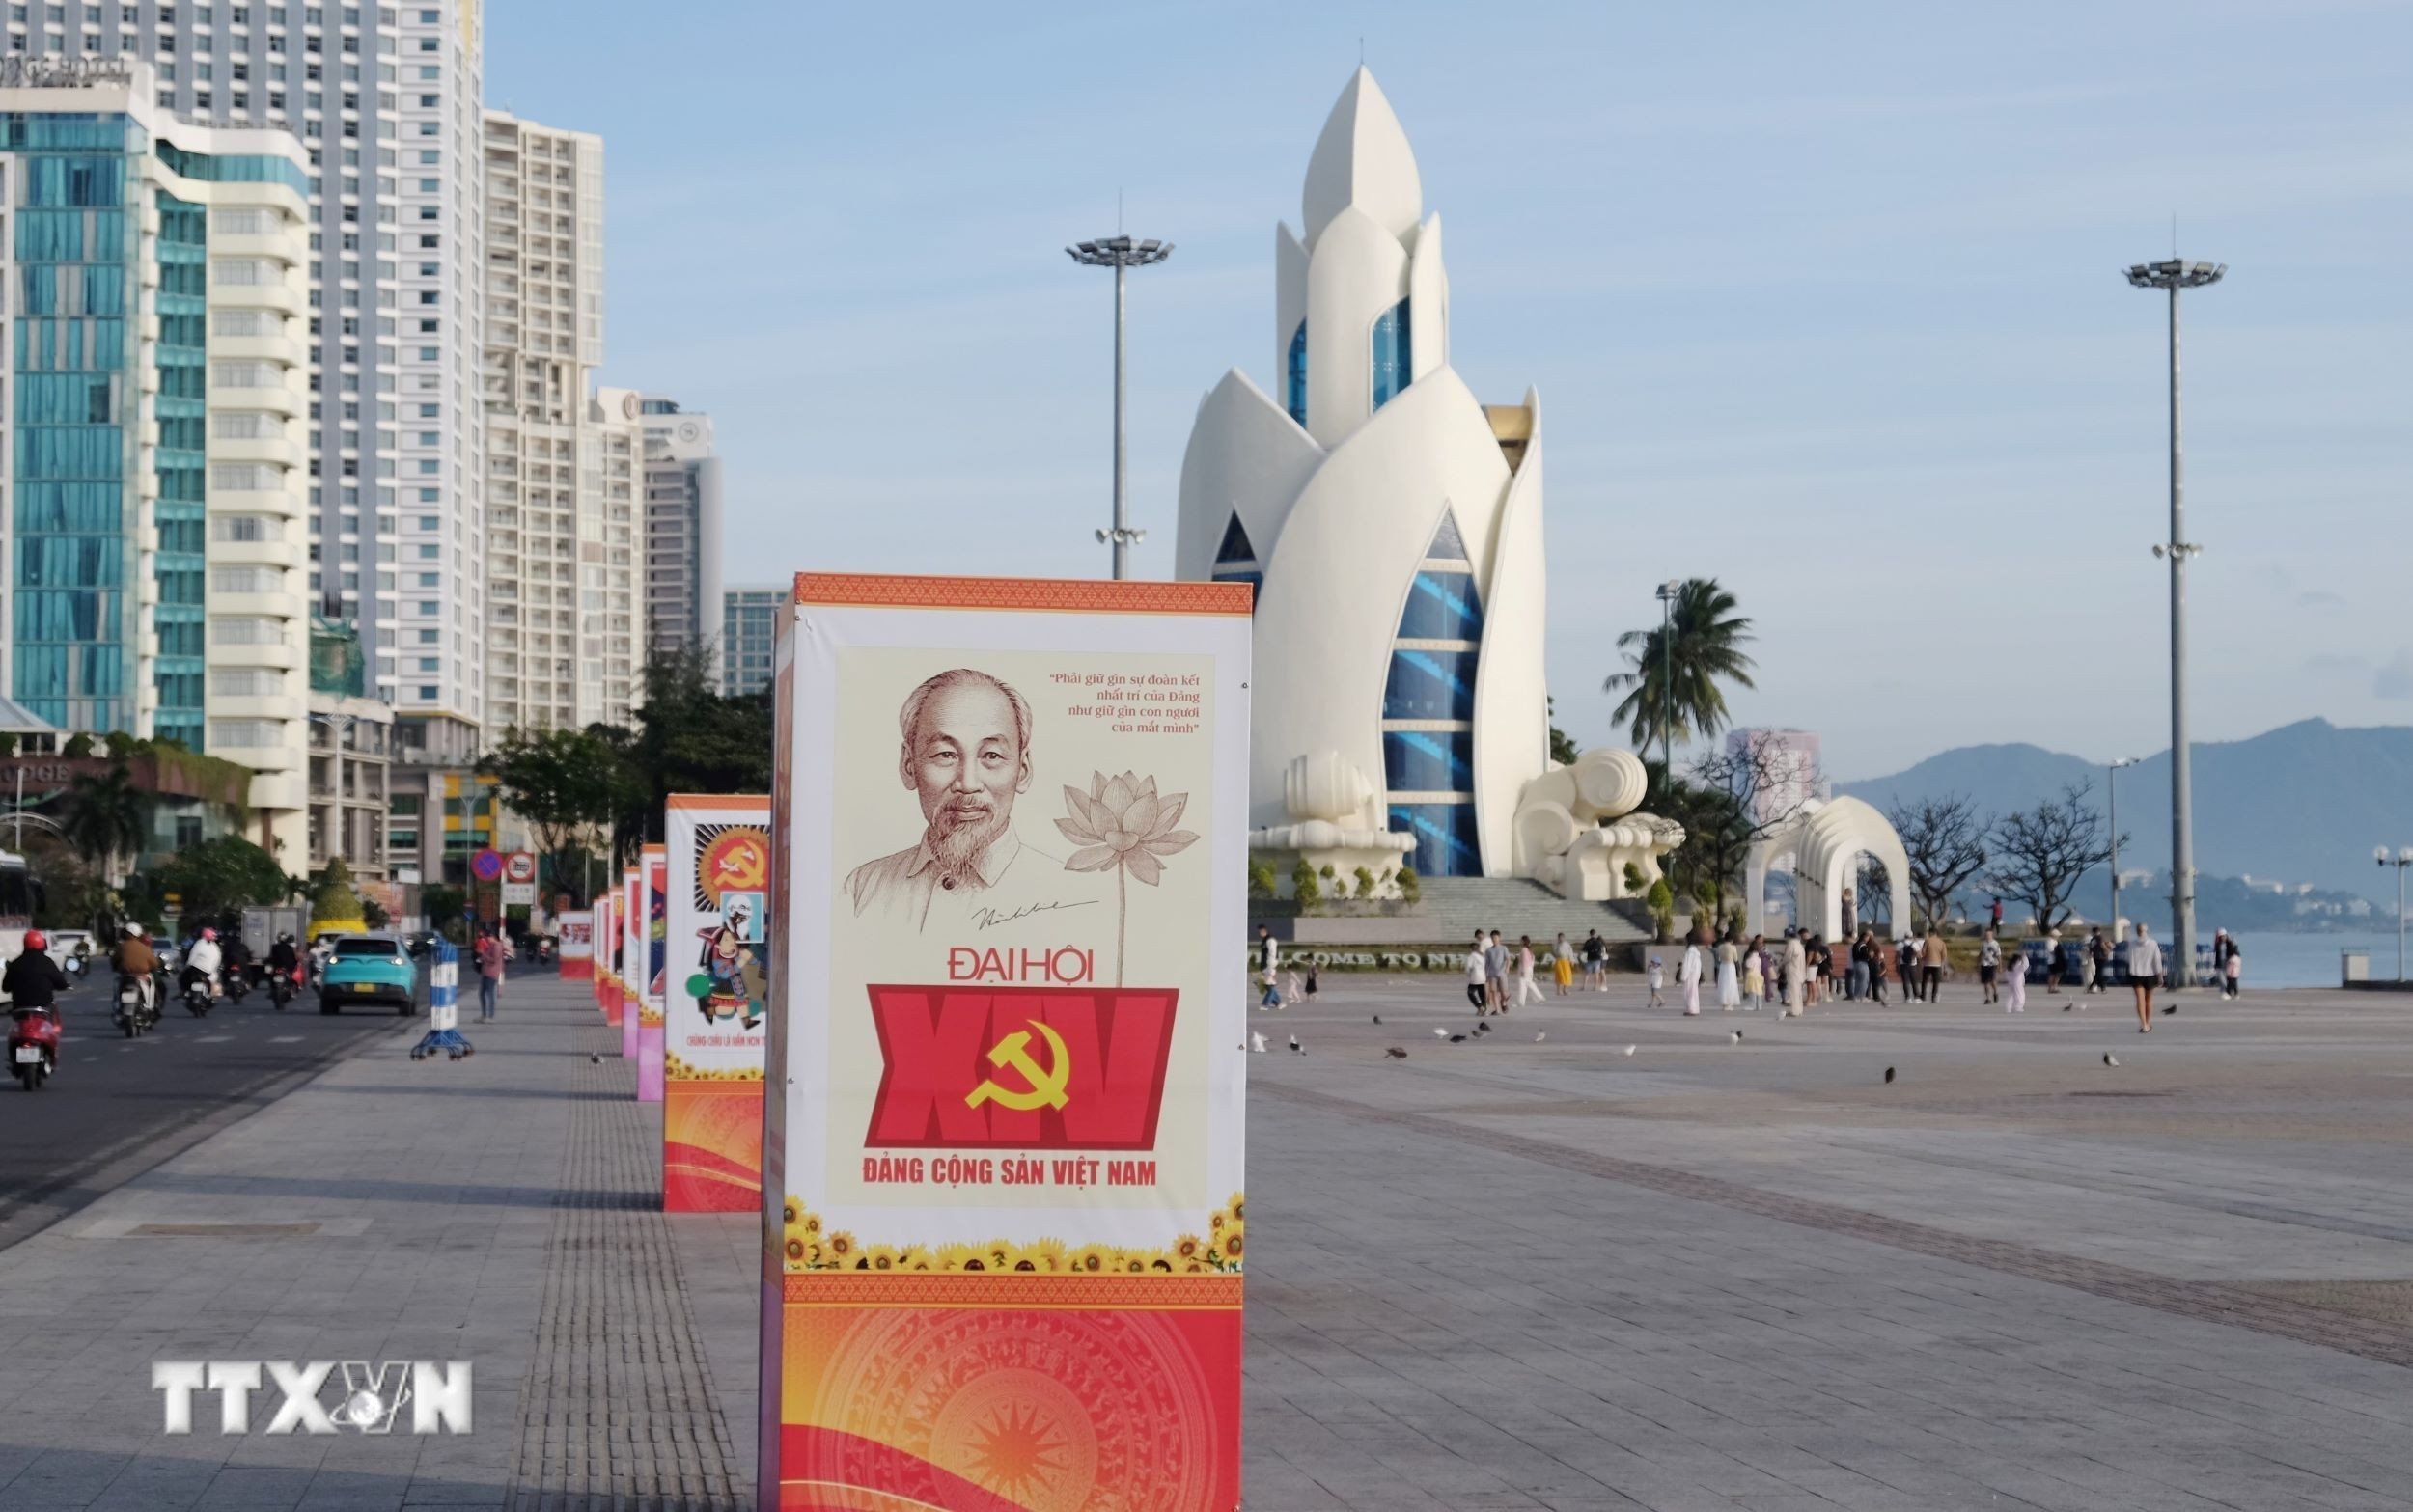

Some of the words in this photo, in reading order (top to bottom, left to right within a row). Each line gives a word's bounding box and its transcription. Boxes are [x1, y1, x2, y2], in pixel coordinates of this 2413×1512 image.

[1085, 673, 1105, 687] giữ
[1107, 673, 1126, 687] gìn
[1130, 674, 1145, 688] sự
[1148, 674, 1178, 686] đoàn
[1181, 673, 1200, 686] kết
[1096, 687, 1123, 701] nhất
[1127, 689, 1140, 701] trí
[1144, 689, 1165, 701] của
[1169, 690, 1201, 704] Đảng
[1068, 704, 1093, 716] như
[1096, 704, 1115, 719] giữ
[1117, 704, 1136, 719] gìn
[1139, 707, 1162, 718] con
[1165, 706, 1200, 720] ngươi
[1111, 720, 1133, 733] của
[1137, 720, 1159, 733] mắt
[947, 947, 1014, 983] ĐẠI
[1021, 944, 1095, 986] HỘI
[1381, 952, 1422, 969] TO
[863, 983, 1180, 1152] XIV
[863, 1151, 924, 1183] ĐẢNG
[931, 1154, 993, 1189] CỘNG
[1001, 1153, 1044, 1185] SẢN
[1052, 1156, 1100, 1190] VIỆT
[1107, 1161, 1157, 1187] NAM
